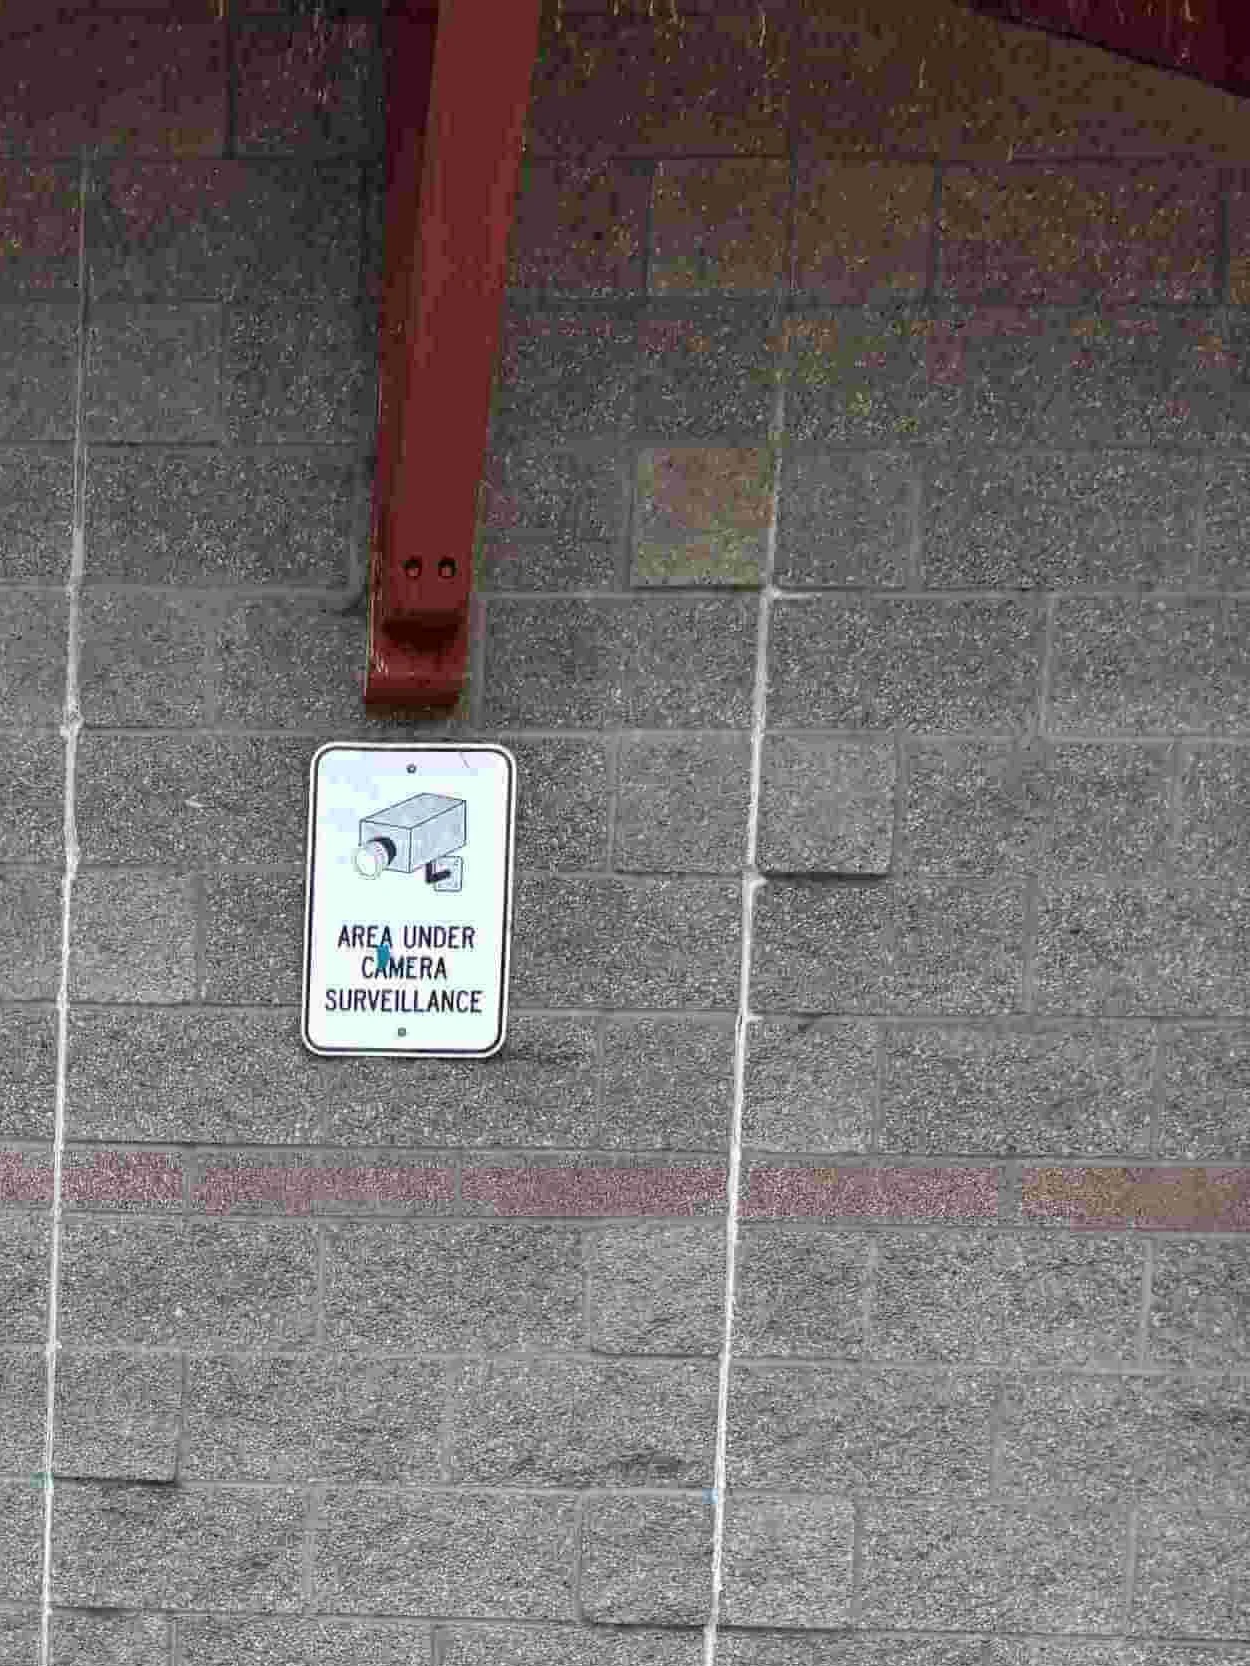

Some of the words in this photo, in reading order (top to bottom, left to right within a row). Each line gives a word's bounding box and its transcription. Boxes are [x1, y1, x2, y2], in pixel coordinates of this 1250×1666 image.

[337, 924, 393, 949] AREA
[403, 925, 476, 949] UNDER
[324, 988, 484, 1013] SURVEILLANCE
